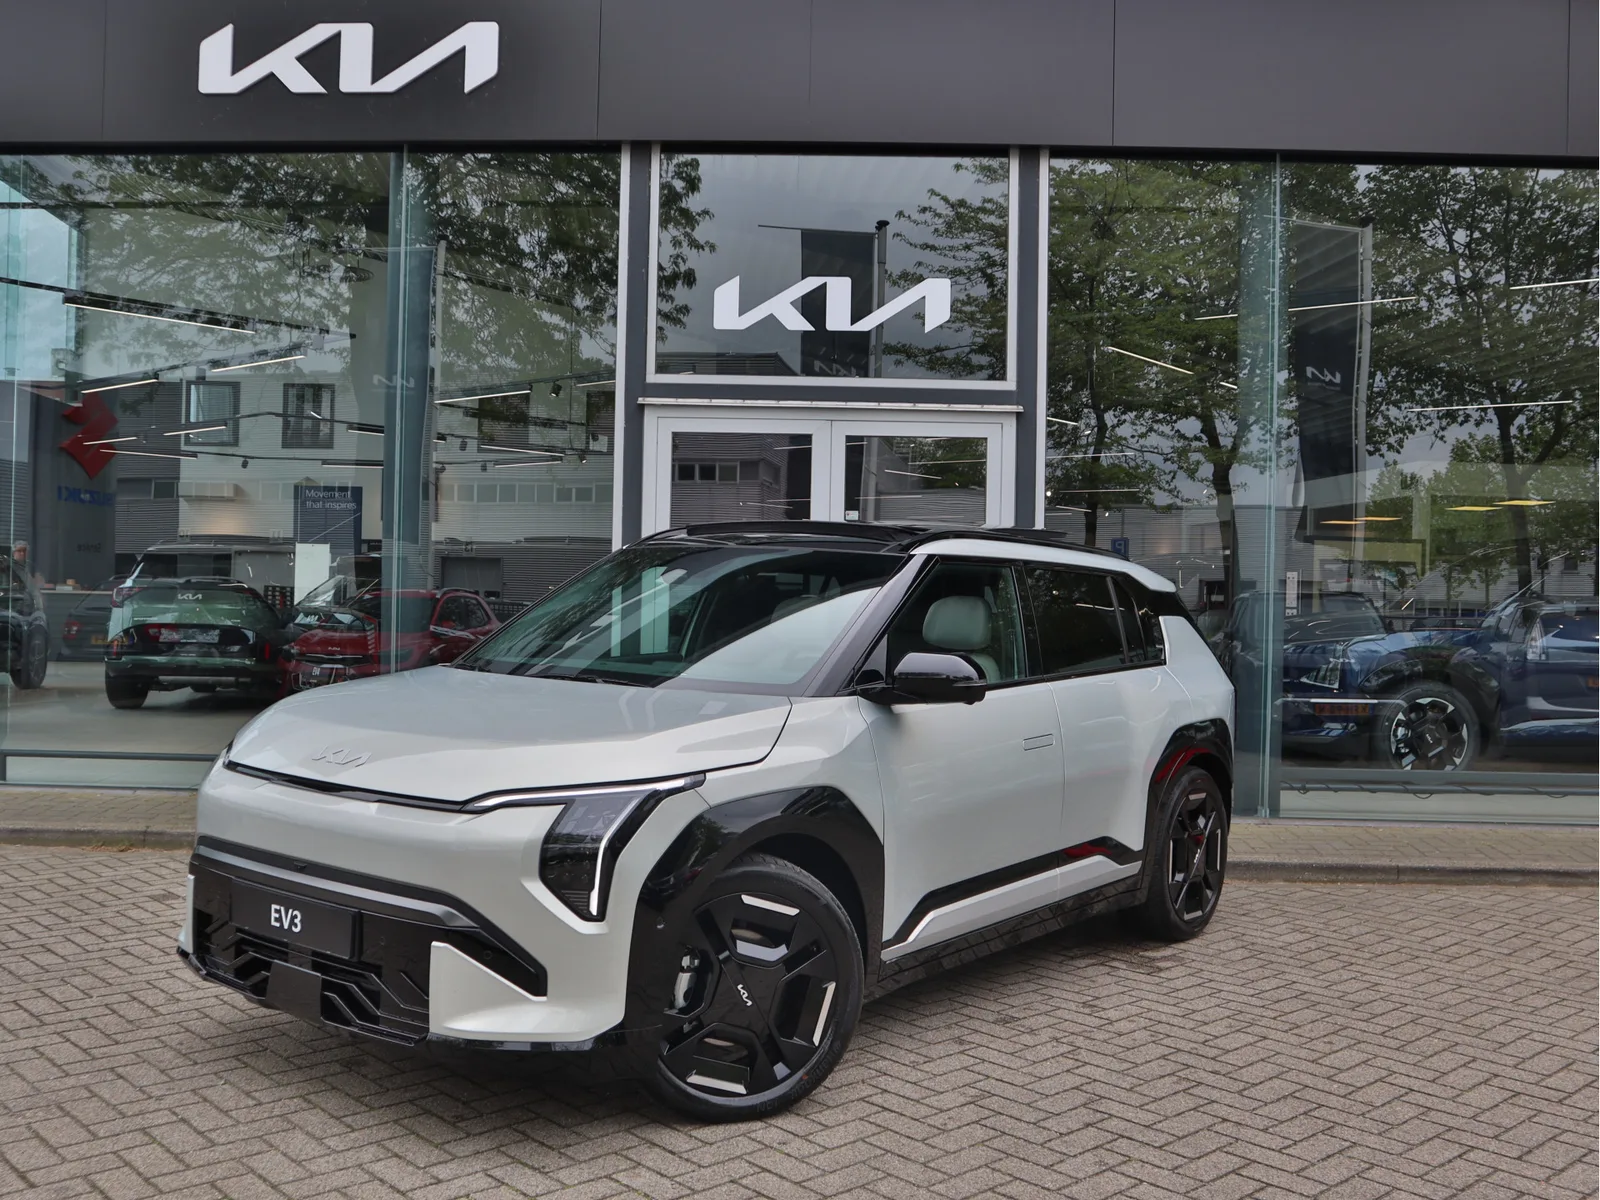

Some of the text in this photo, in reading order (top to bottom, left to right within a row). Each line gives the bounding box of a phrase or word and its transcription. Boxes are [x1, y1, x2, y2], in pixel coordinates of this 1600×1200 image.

[198, 21, 499, 94] KIA
[713, 275, 951, 333] KIA
[305, 489, 351, 499] Movement
[306, 500, 357, 511] that inspires
[311, 745, 373, 768] KIA
[270, 903, 302, 933] EV3
